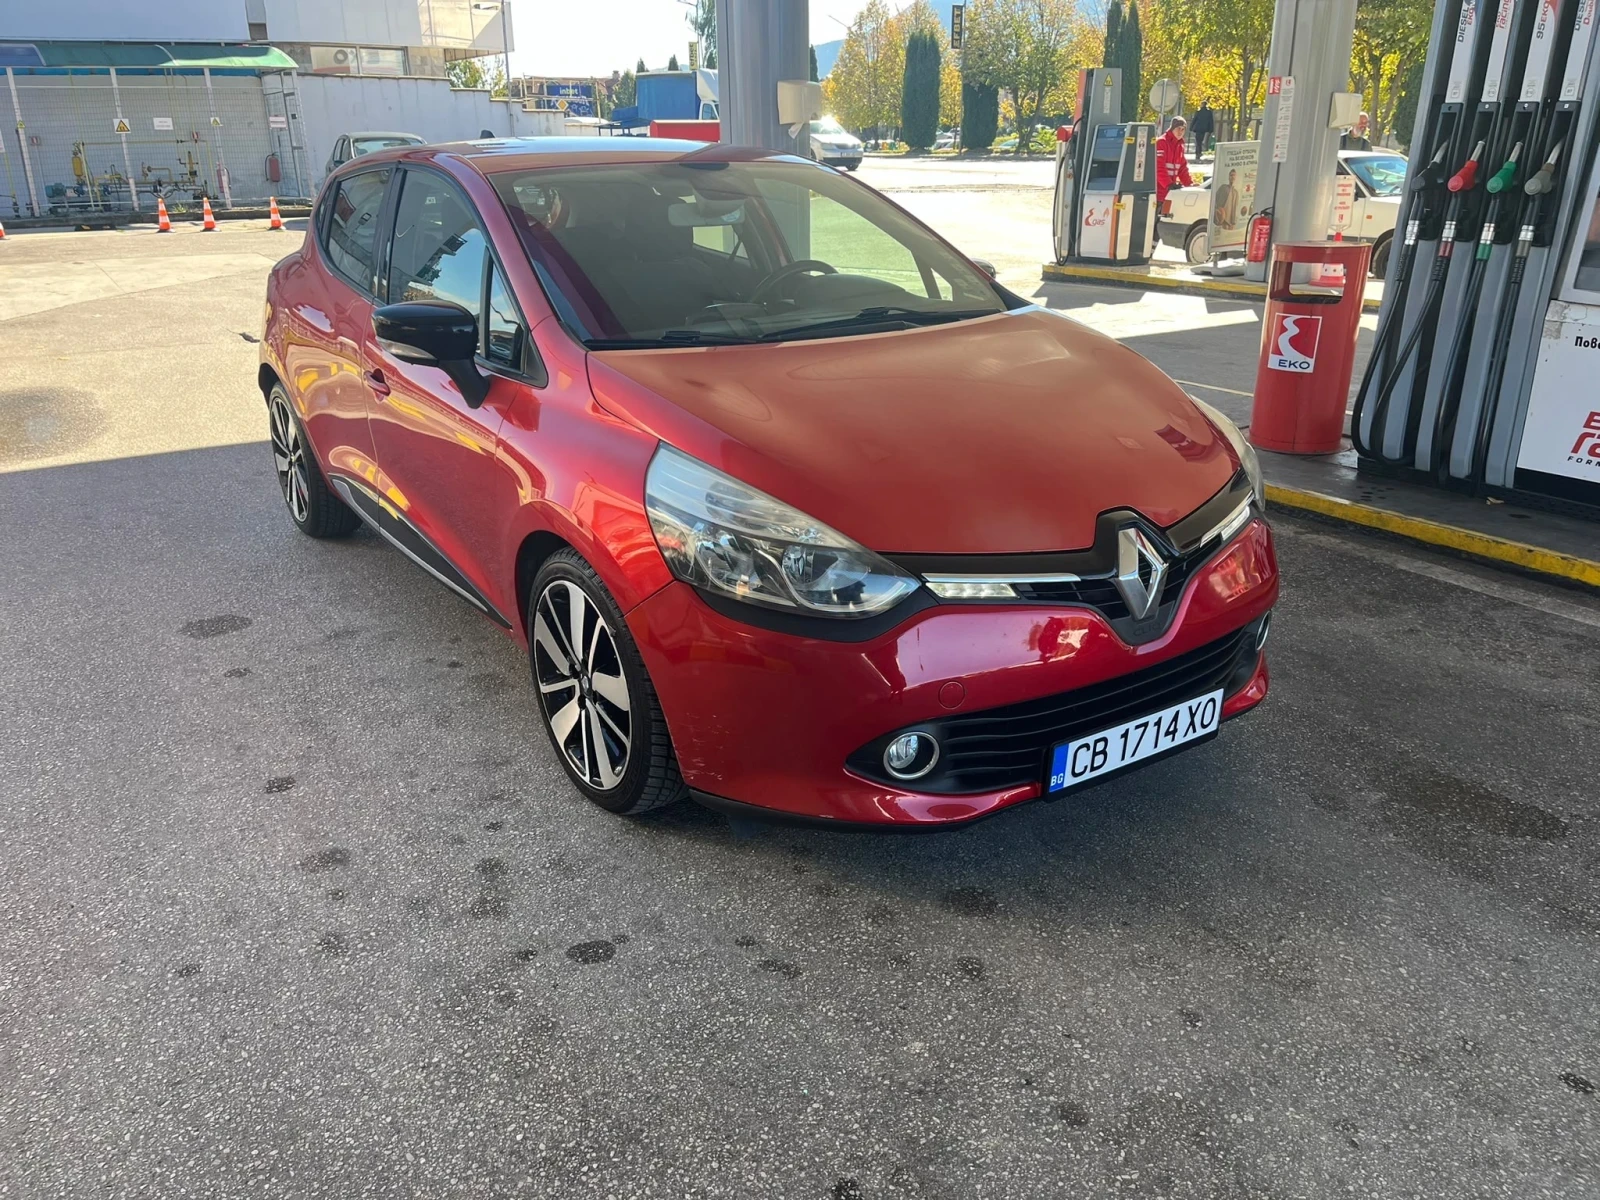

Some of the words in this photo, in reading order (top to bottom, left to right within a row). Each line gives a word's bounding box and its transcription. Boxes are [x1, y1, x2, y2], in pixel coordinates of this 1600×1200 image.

[1457, 7, 1469, 43] DIESEL
[1278, 358, 1310, 370] EKO
[1070, 736, 1109, 779] CB
[1051, 773, 1064, 786] BG
